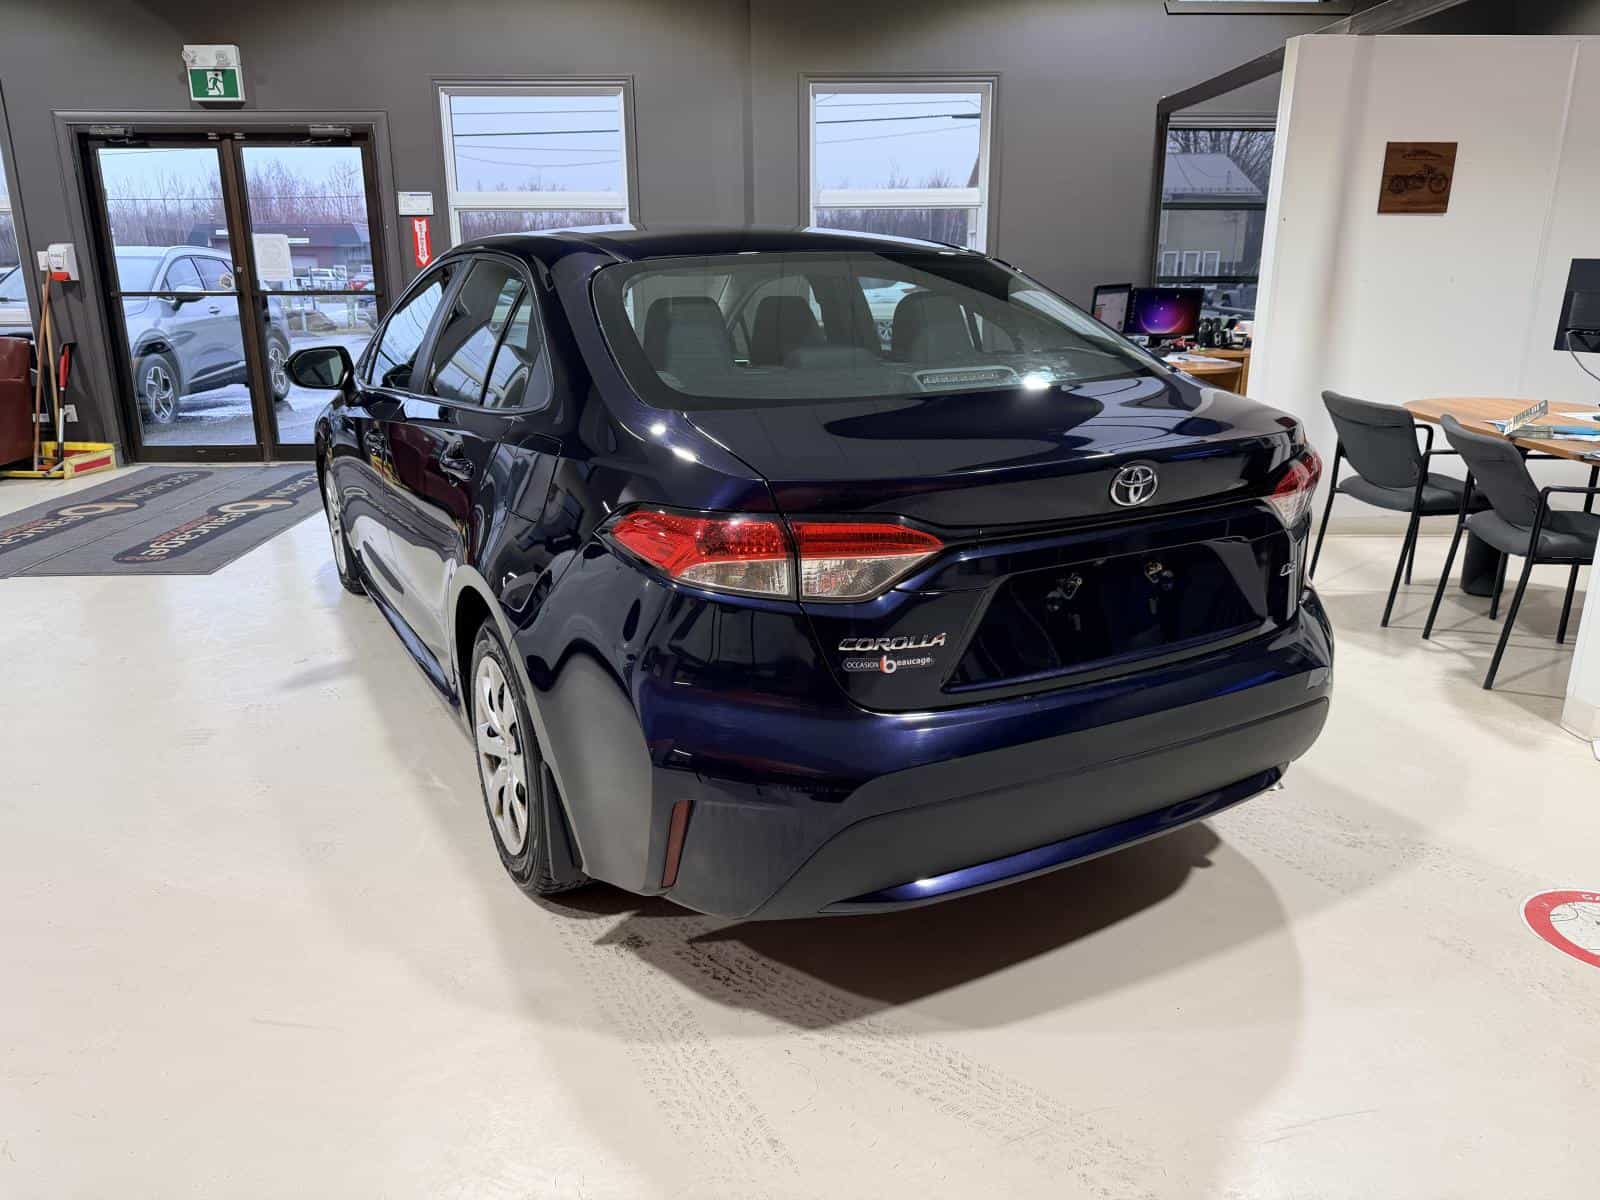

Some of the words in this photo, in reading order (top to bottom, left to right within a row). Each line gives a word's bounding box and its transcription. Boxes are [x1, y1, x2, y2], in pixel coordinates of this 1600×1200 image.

[838, 632, 947, 651] COROLLA
[846, 661, 880, 669] OCCASION
[881, 655, 932, 673] beaucage
